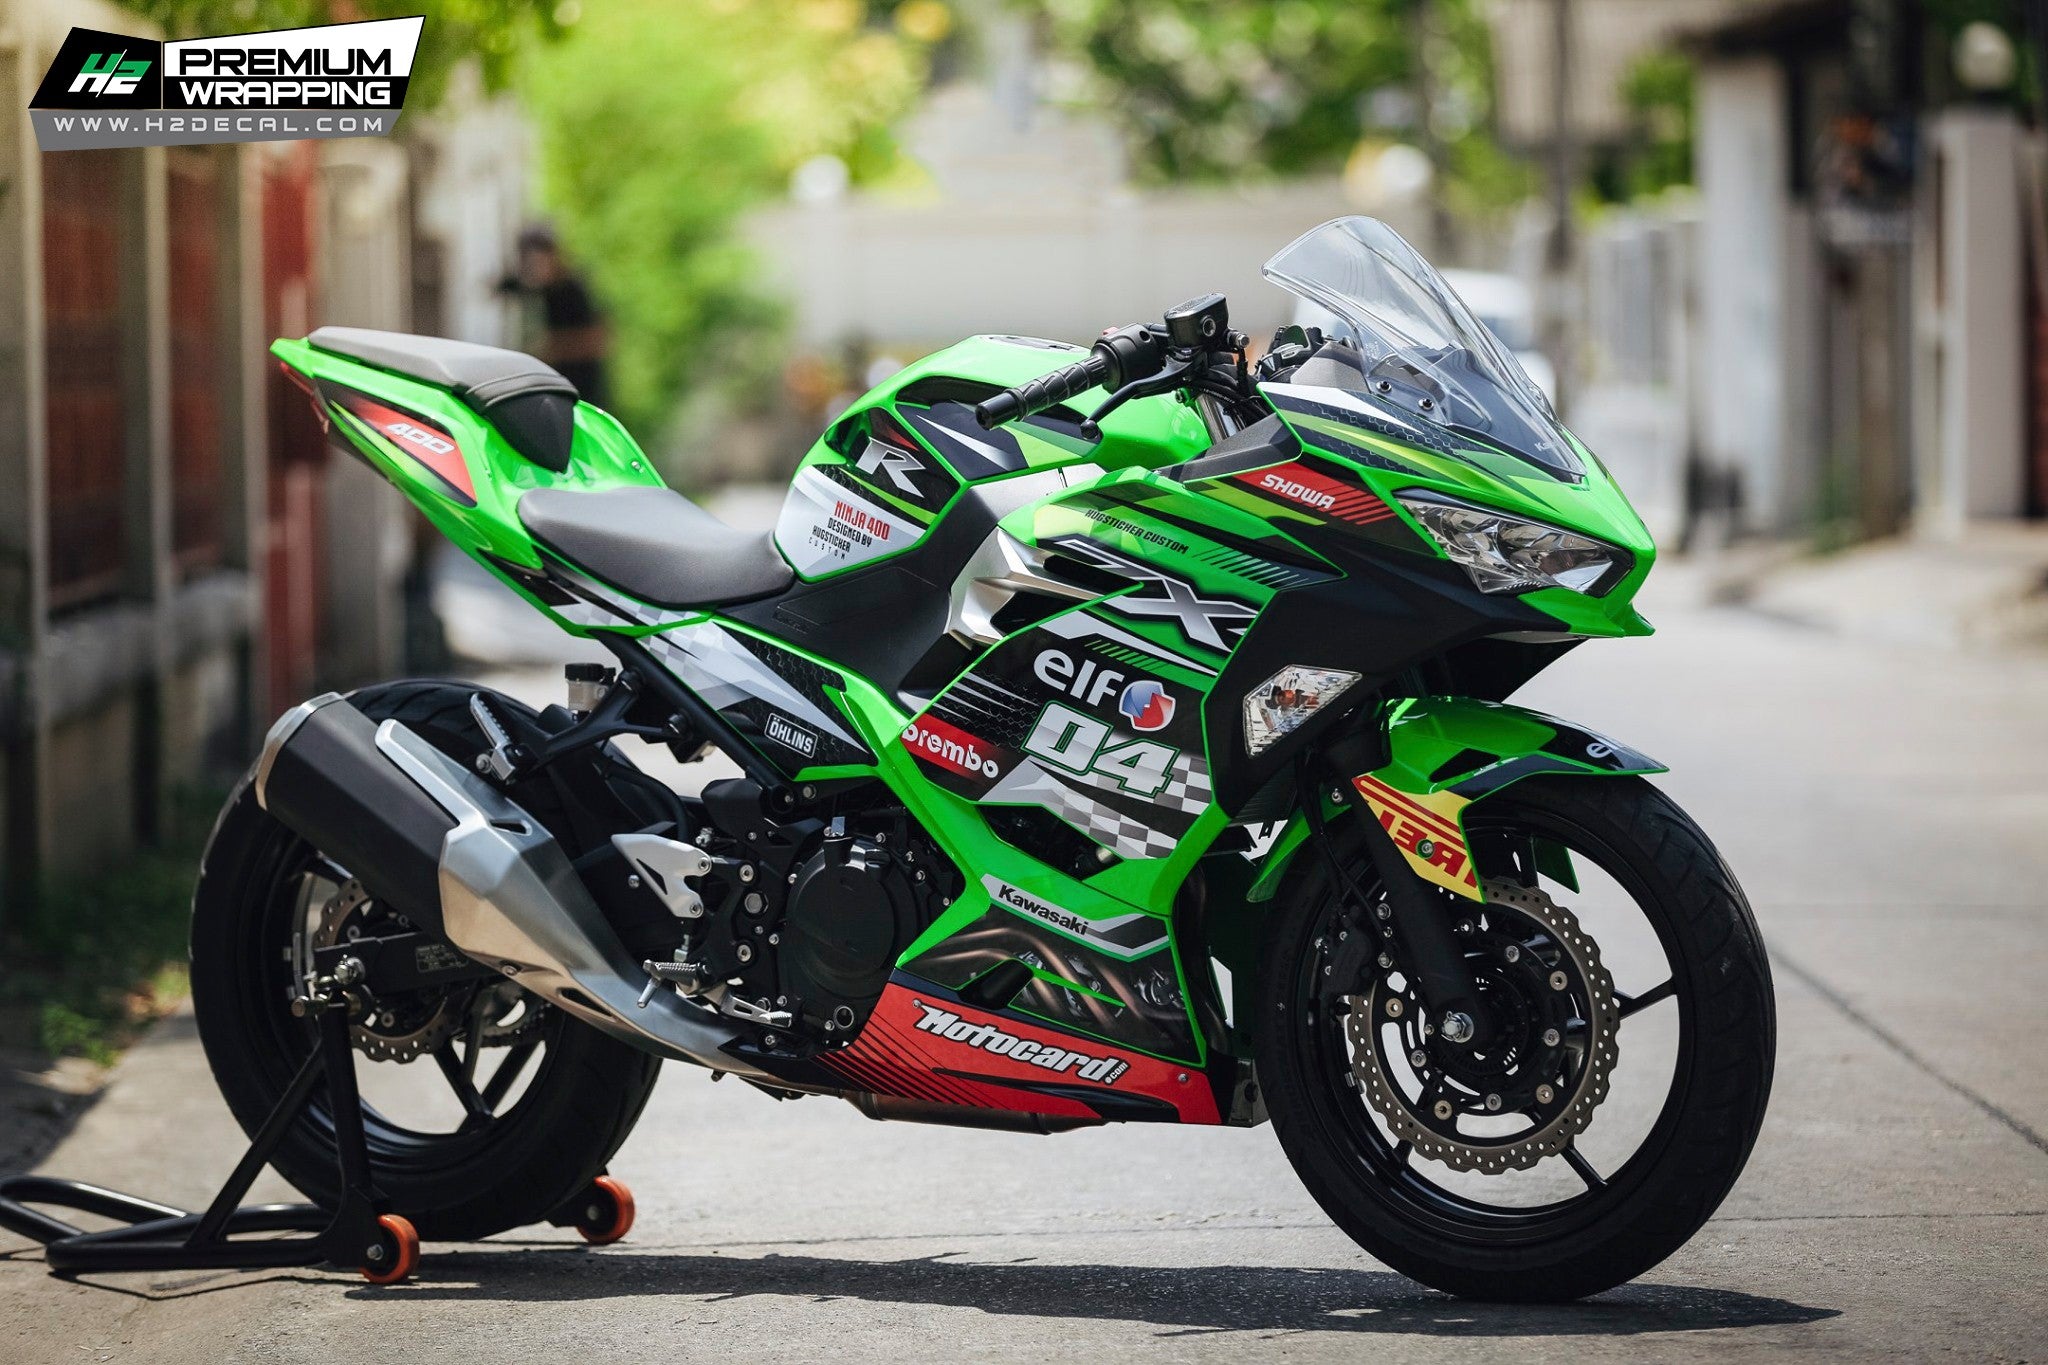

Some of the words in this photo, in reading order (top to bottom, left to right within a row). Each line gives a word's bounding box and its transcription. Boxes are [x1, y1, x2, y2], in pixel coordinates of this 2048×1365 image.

[855, 436, 927, 498] R
[1260, 474, 1336, 509] SHOWA
[827, 517, 861, 543] DESIGNED
[861, 534, 873, 548] BY
[833, 500, 867, 528] NINJA
[866, 515, 890, 540] 400
[1143, 531, 1190, 555] CUSTOM
[1033, 649, 1125, 707] elf
[768, 717, 814, 753] ÖHLINS
[901, 723, 999, 778] brembo
[1020, 700, 1181, 798] 04
[998, 884, 1089, 935] Kawasaki
